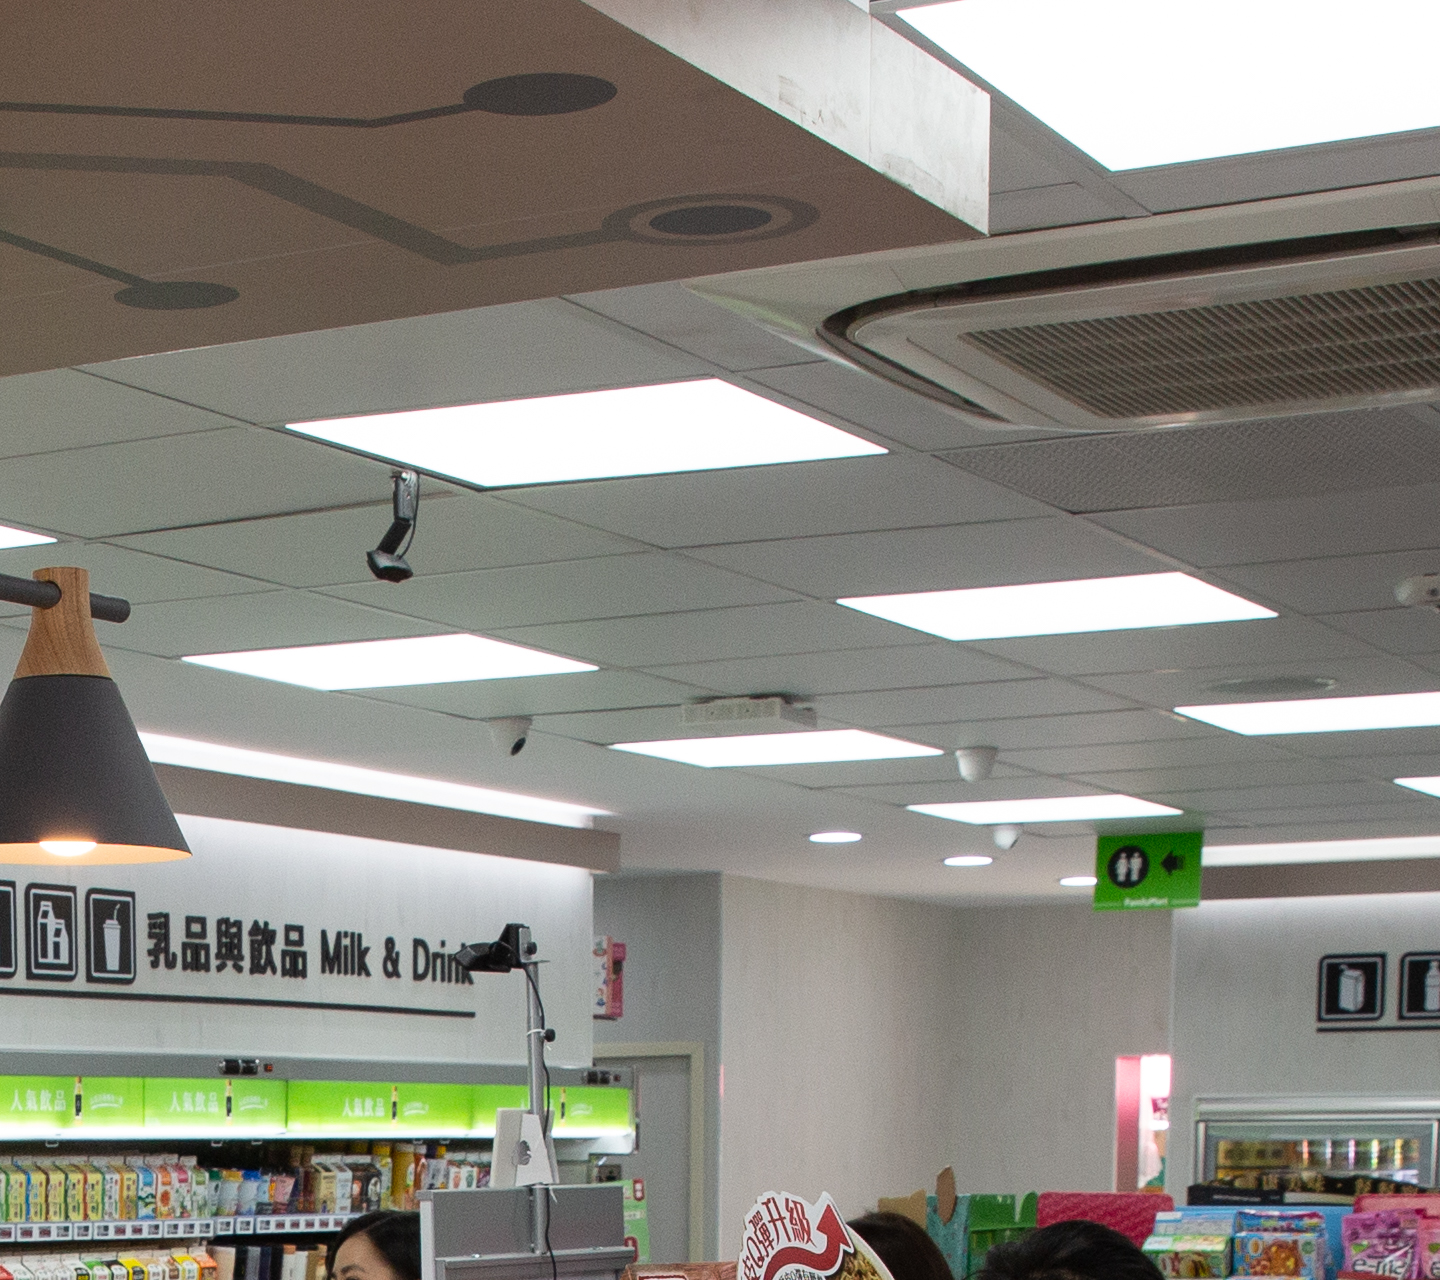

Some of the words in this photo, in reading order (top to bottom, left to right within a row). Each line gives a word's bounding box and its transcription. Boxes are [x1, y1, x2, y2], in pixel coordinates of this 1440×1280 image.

[146, 910, 308, 980] 乳品與飲品
[320, 928, 373, 979] Milk
[381, 938, 400, 976] &
[10, 1089, 67, 1112] 人氣飲品
